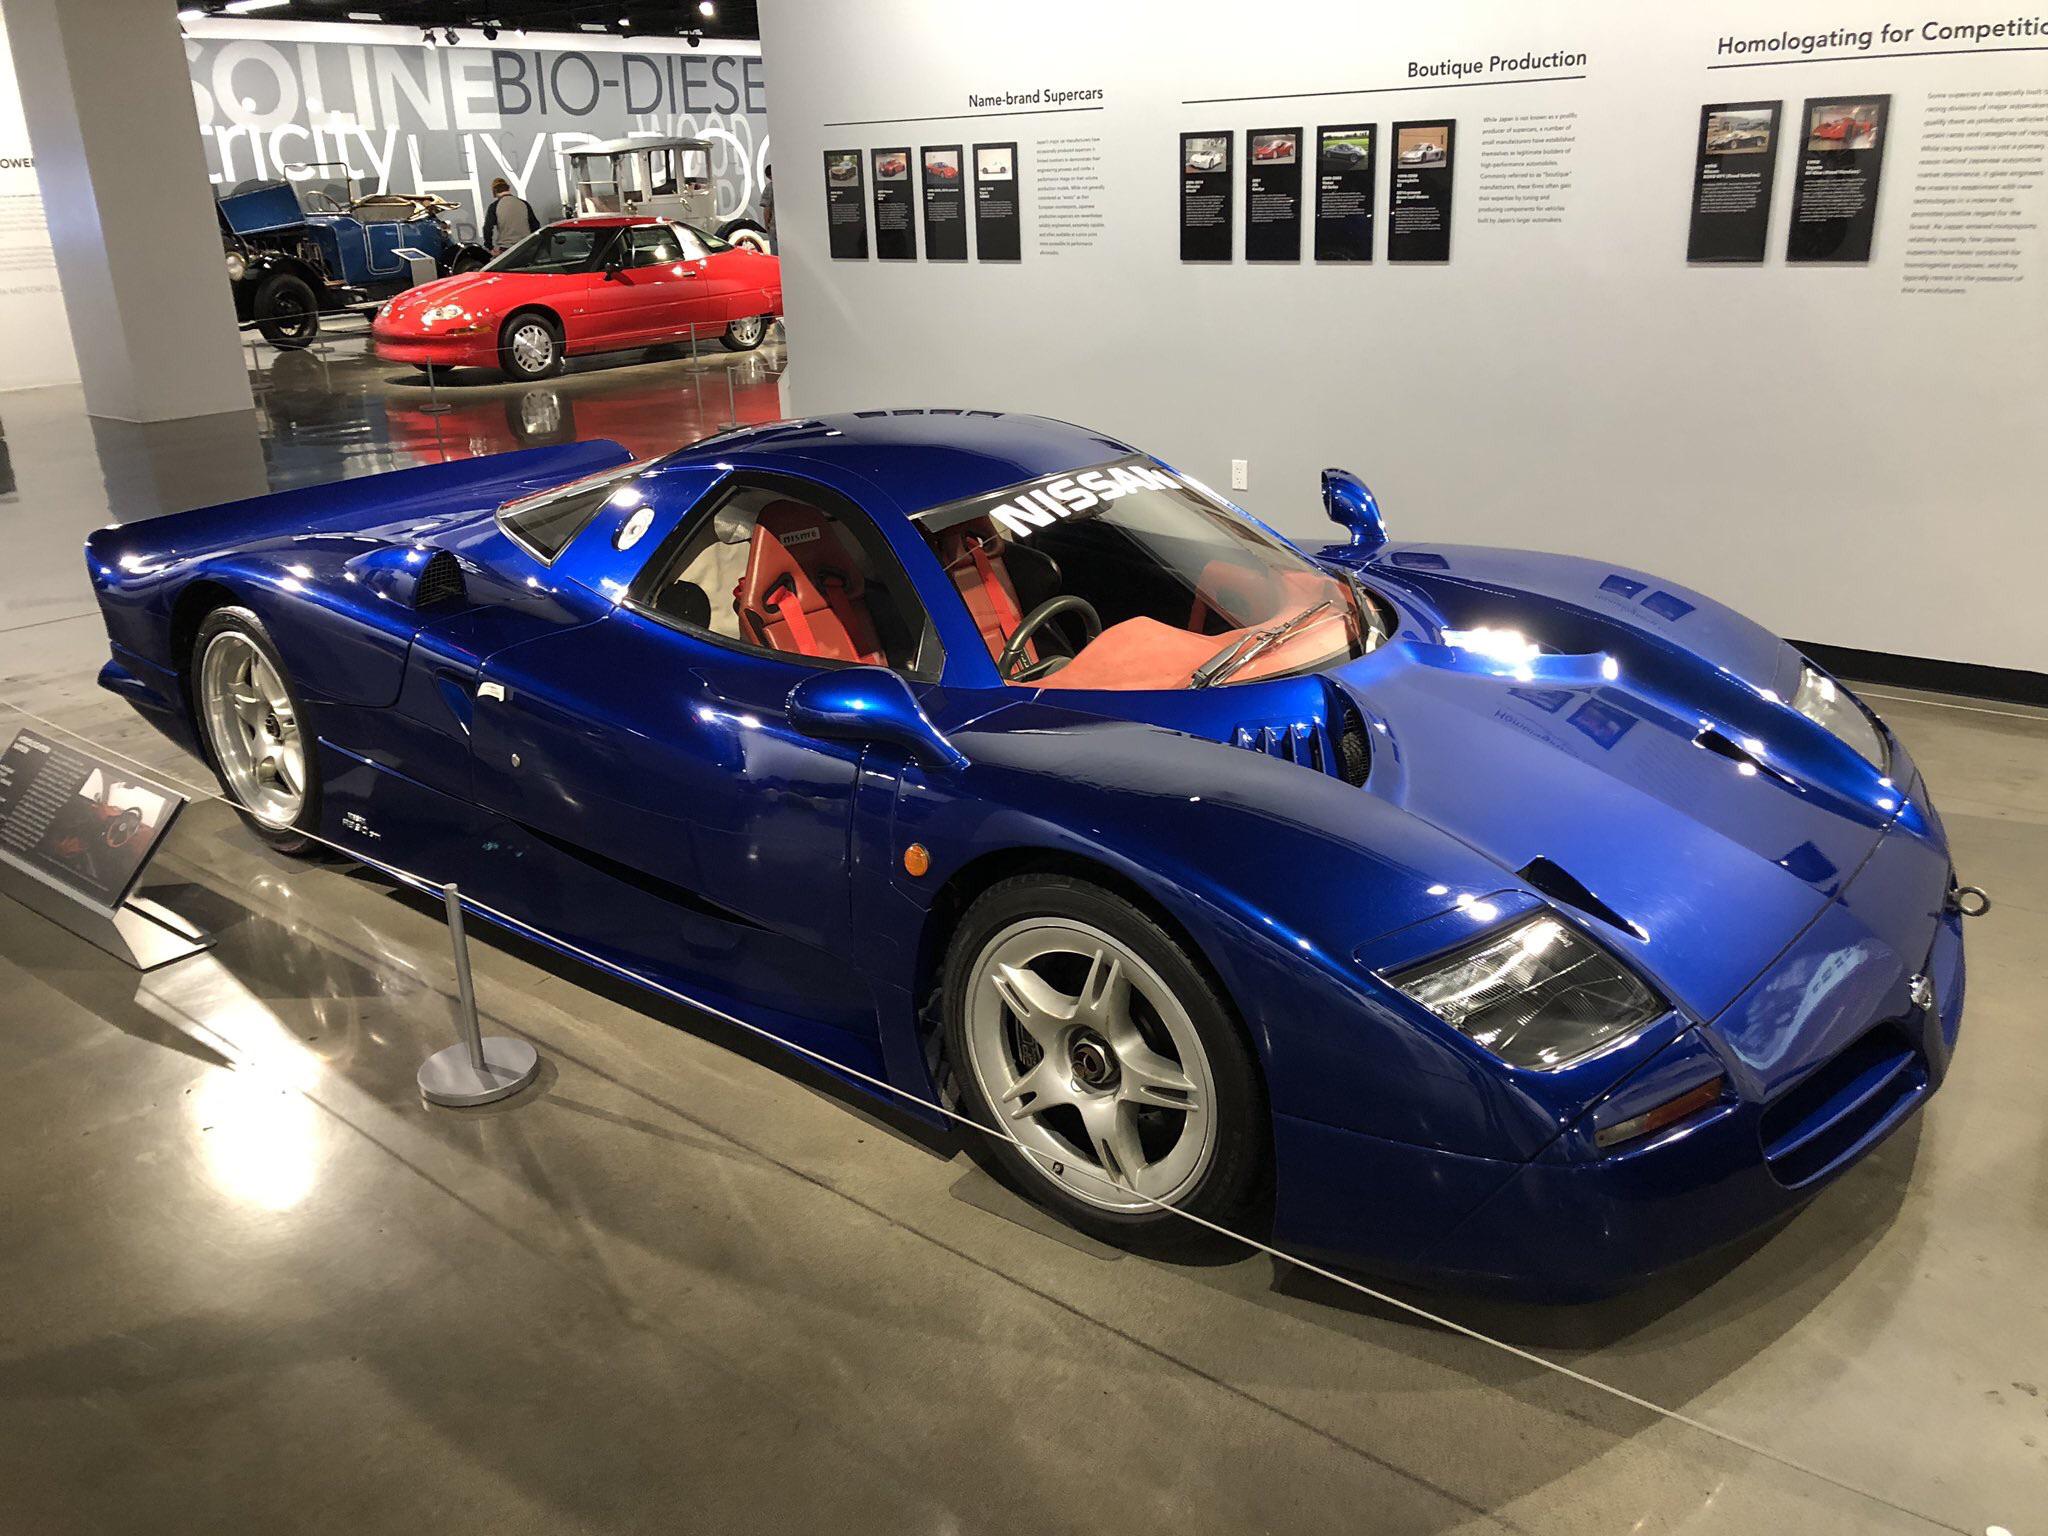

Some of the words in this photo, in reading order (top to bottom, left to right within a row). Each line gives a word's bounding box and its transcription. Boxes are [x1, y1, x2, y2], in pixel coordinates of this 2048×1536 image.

[1717, 28, 1873, 54] Homologating
[1881, 23, 1914, 43] for
[1407, 59, 1483, 79] Boutique
[1489, 50, 1587, 72] Production
[968, 89, 1040, 107] Name-brand
[1044, 89, 1103, 105] Supercars
[0, 157, 35, 169] OWE
[989, 465, 1183, 538] NISSAN
